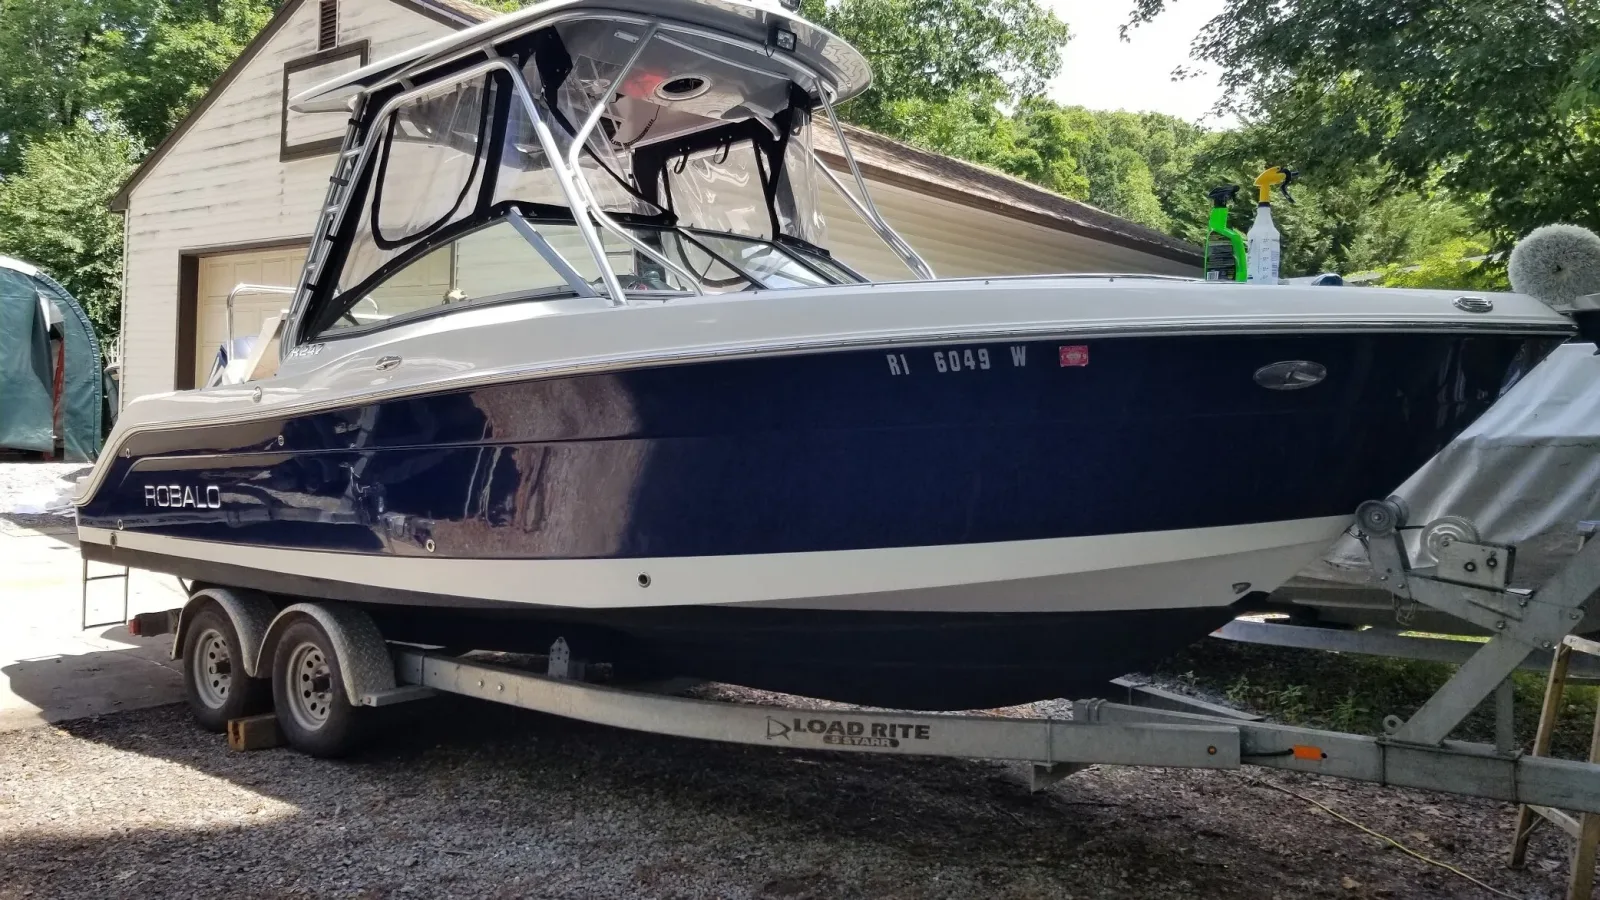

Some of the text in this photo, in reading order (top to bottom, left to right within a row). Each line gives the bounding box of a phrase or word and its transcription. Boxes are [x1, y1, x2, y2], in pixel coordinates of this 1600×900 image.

[886, 345, 1027, 376] RI 6049 W
[144, 485, 221, 509] ROBALO
[793, 718, 930, 740] LOAD RITE
